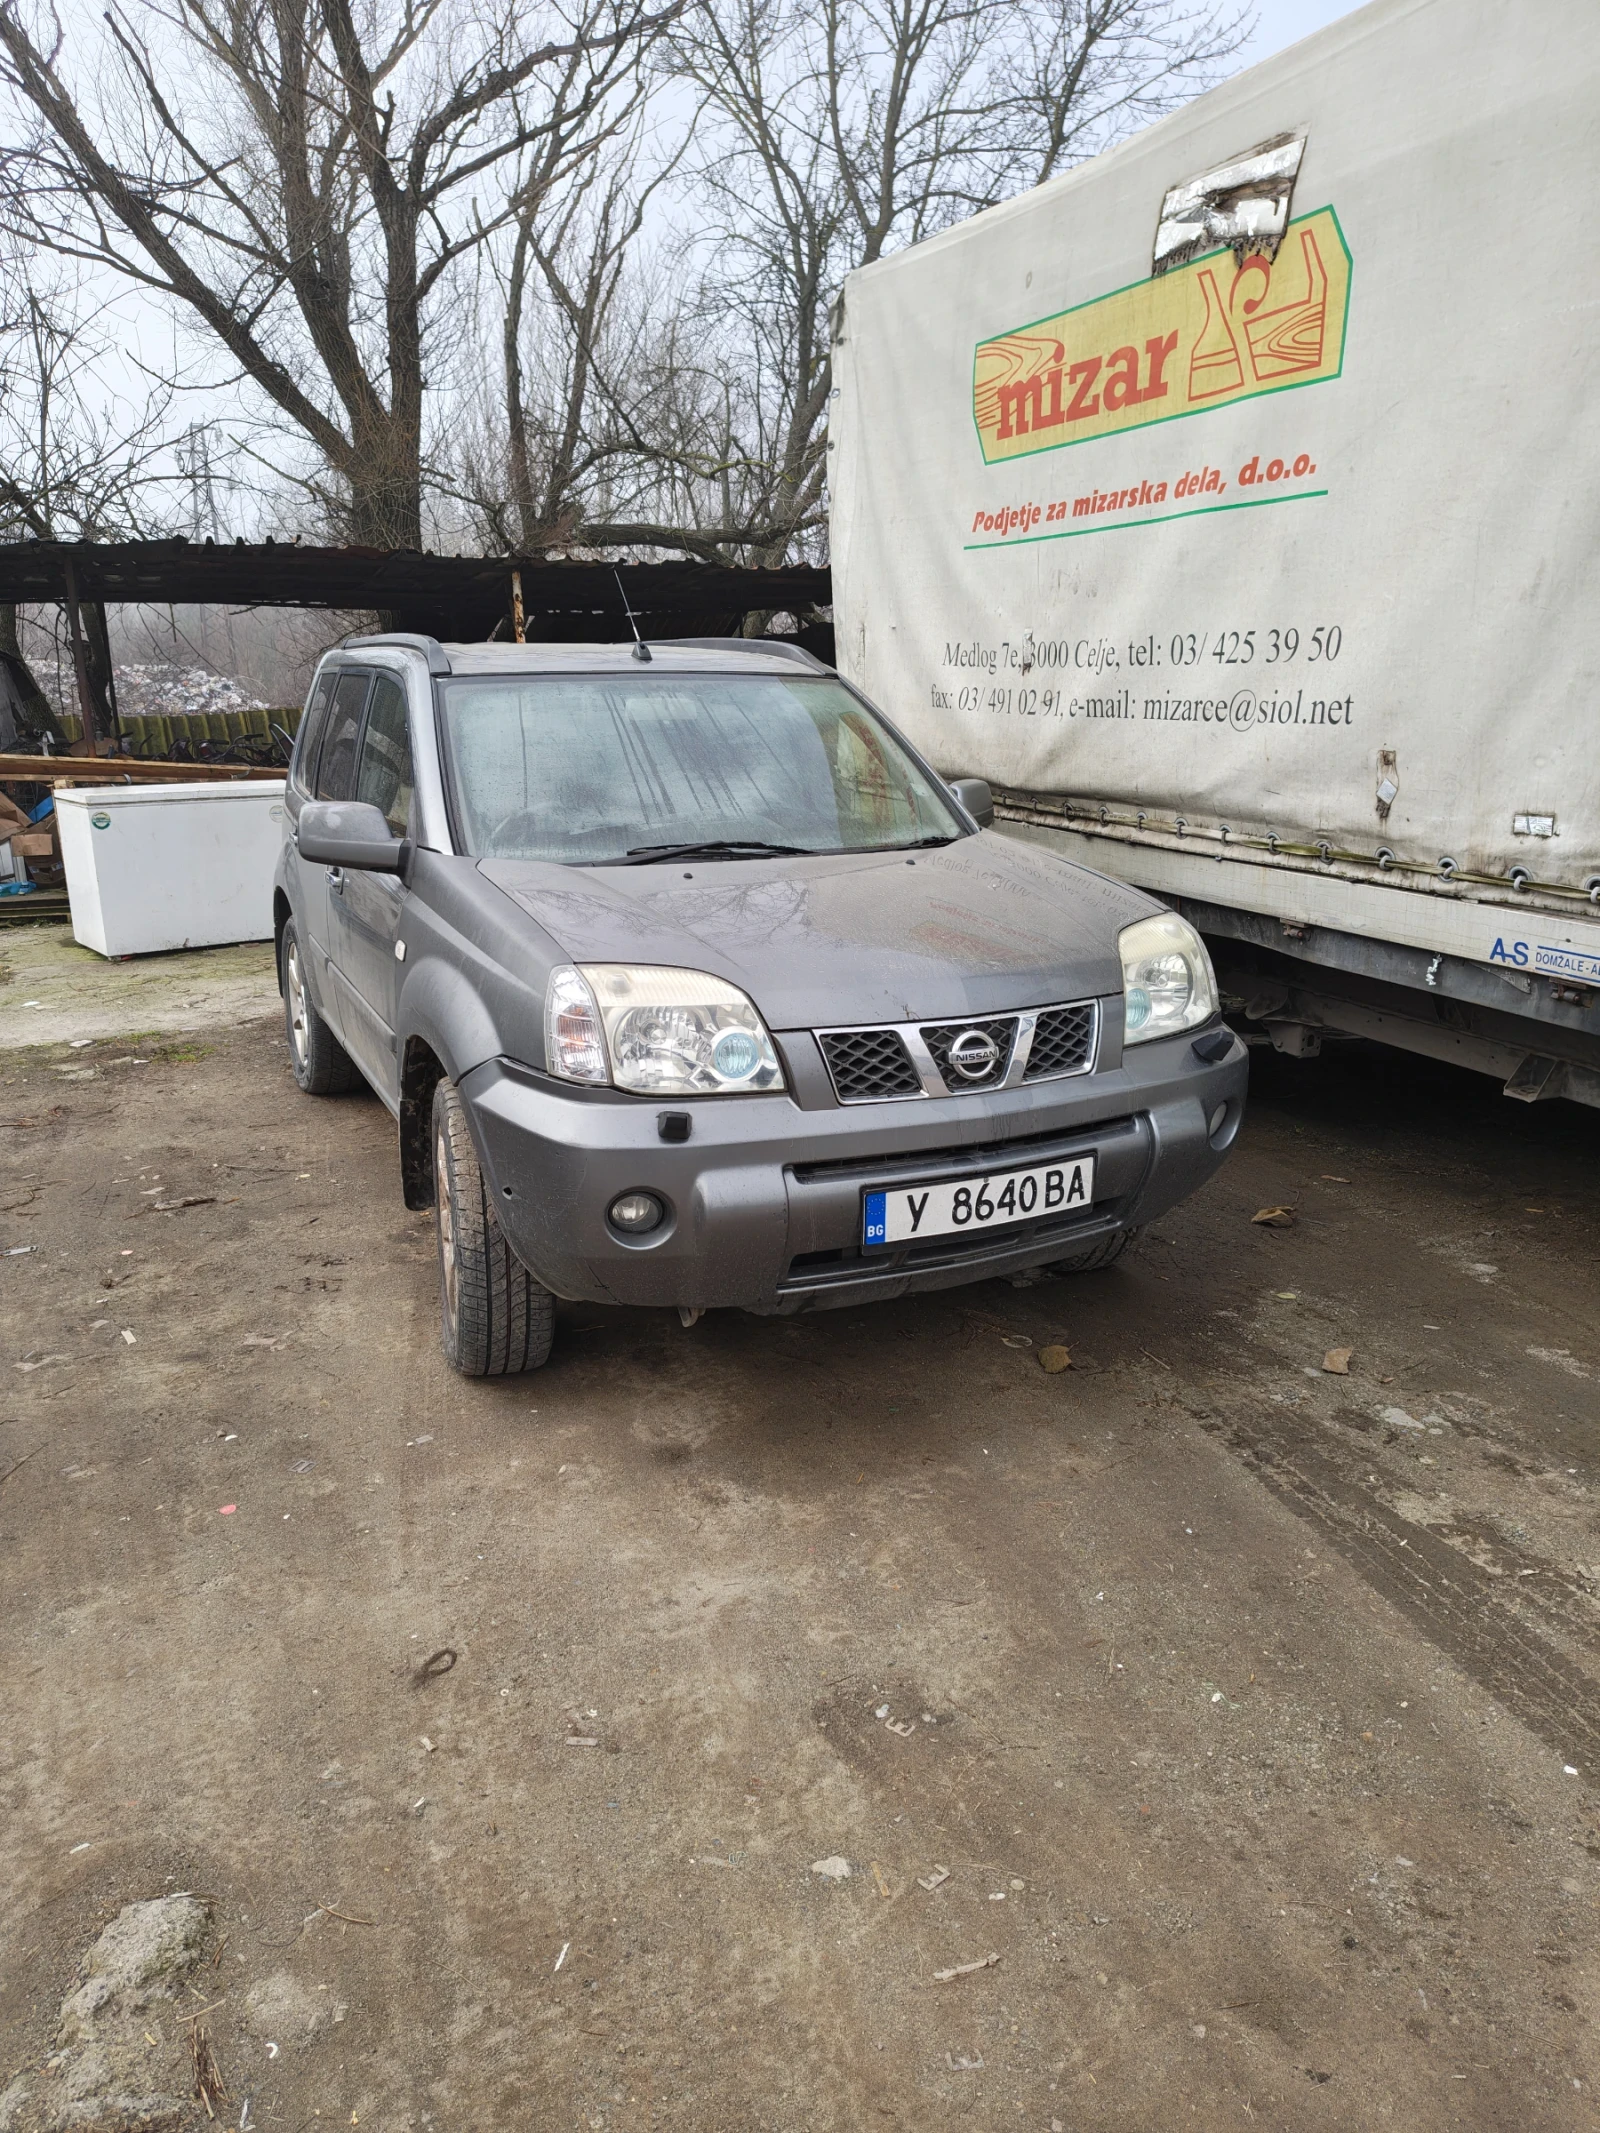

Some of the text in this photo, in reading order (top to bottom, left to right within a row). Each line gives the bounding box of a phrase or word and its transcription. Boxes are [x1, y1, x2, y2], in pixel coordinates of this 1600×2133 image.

[997, 329, 1179, 440] mizar
[972, 454, 1317, 536] Podjetje za mizarska dela, d.o.o.
[941, 642, 997, 675] Medlog
[1002, 642, 1021, 673] 7e,
[1075, 638, 1120, 675] Celje,
[1128, 635, 1161, 666] tel:
[1266, 628, 1299, 663] 39
[1308, 625, 1342, 661] 50
[931, 684, 953, 709] fax:
[1018, 689, 1037, 715] 02
[1043, 689, 1063, 722] 91,
[1070, 689, 1136, 719] e-mail:
[1143, 689, 1354, 732] mizarce@siol.net
[956, 1050, 996, 1061] NISSAN
[952, 1175, 1037, 1225] 8640
[1044, 1165, 1085, 1209] BA
[867, 1224, 884, 1237] BG
